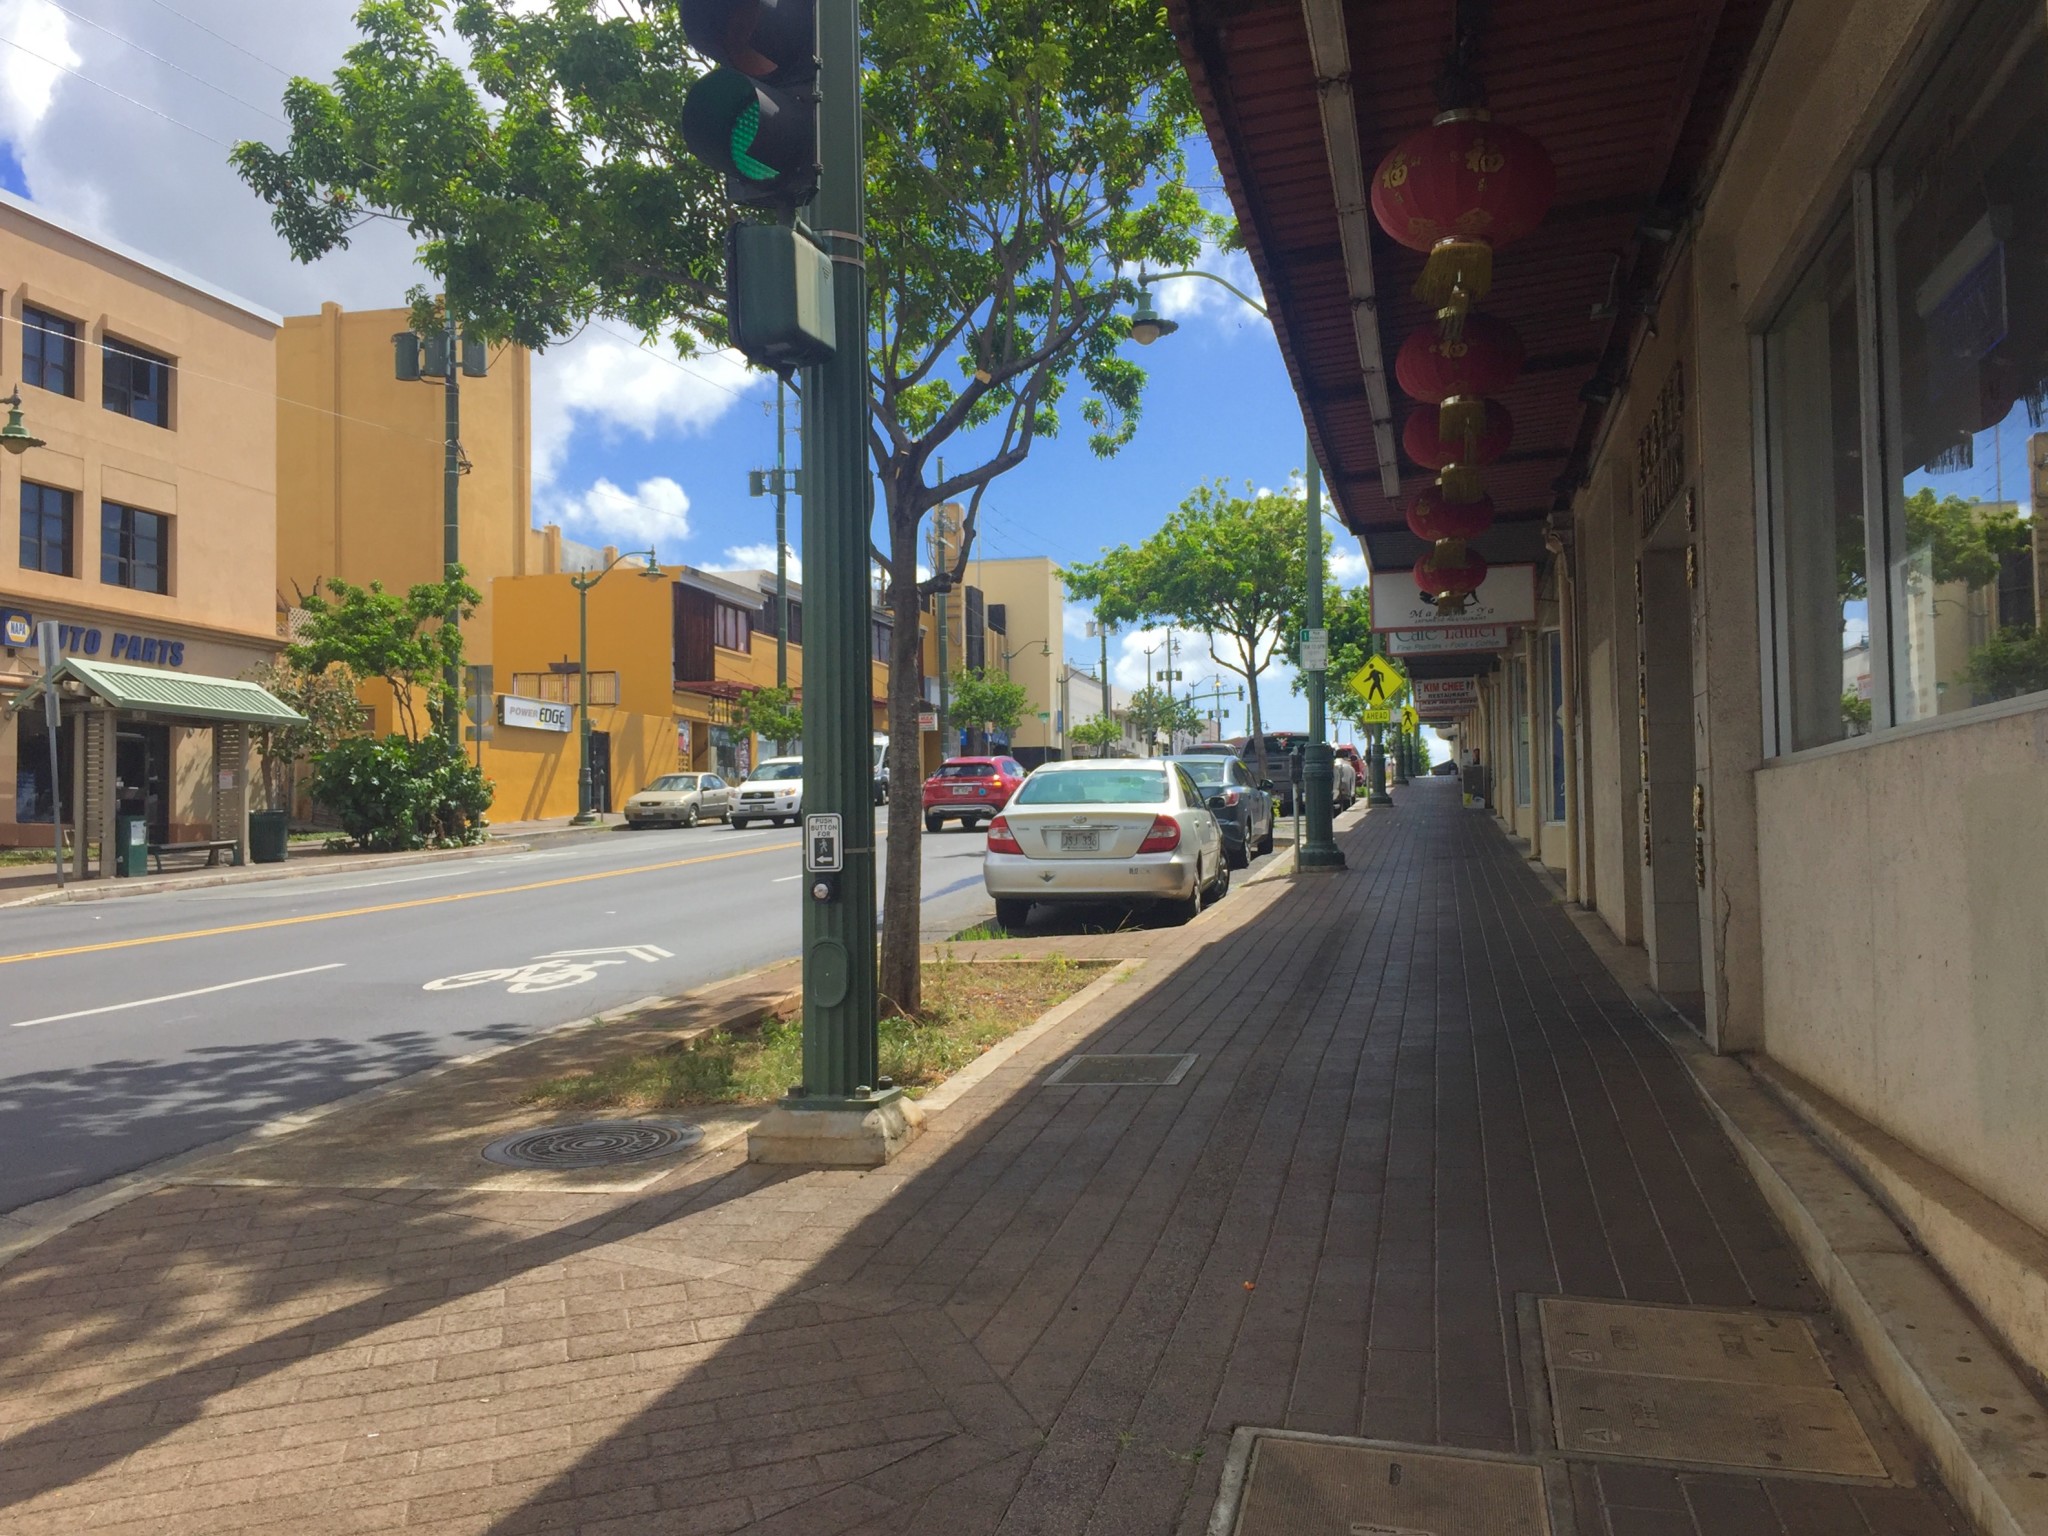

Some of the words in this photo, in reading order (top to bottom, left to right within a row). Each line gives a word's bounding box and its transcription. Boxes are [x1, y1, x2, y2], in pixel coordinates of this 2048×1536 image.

[10, 621, 26, 635] NAPA
[111, 632, 185, 667] PARTS
[1423, 683, 1440, 692] KIM
[1442, 681, 1464, 691] CHEE
[509, 706, 538, 718] POWER
[539, 707, 565, 725] EDGE
[1366, 712, 1388, 720] AHEAD
[1082, 835, 1097, 846] 336
